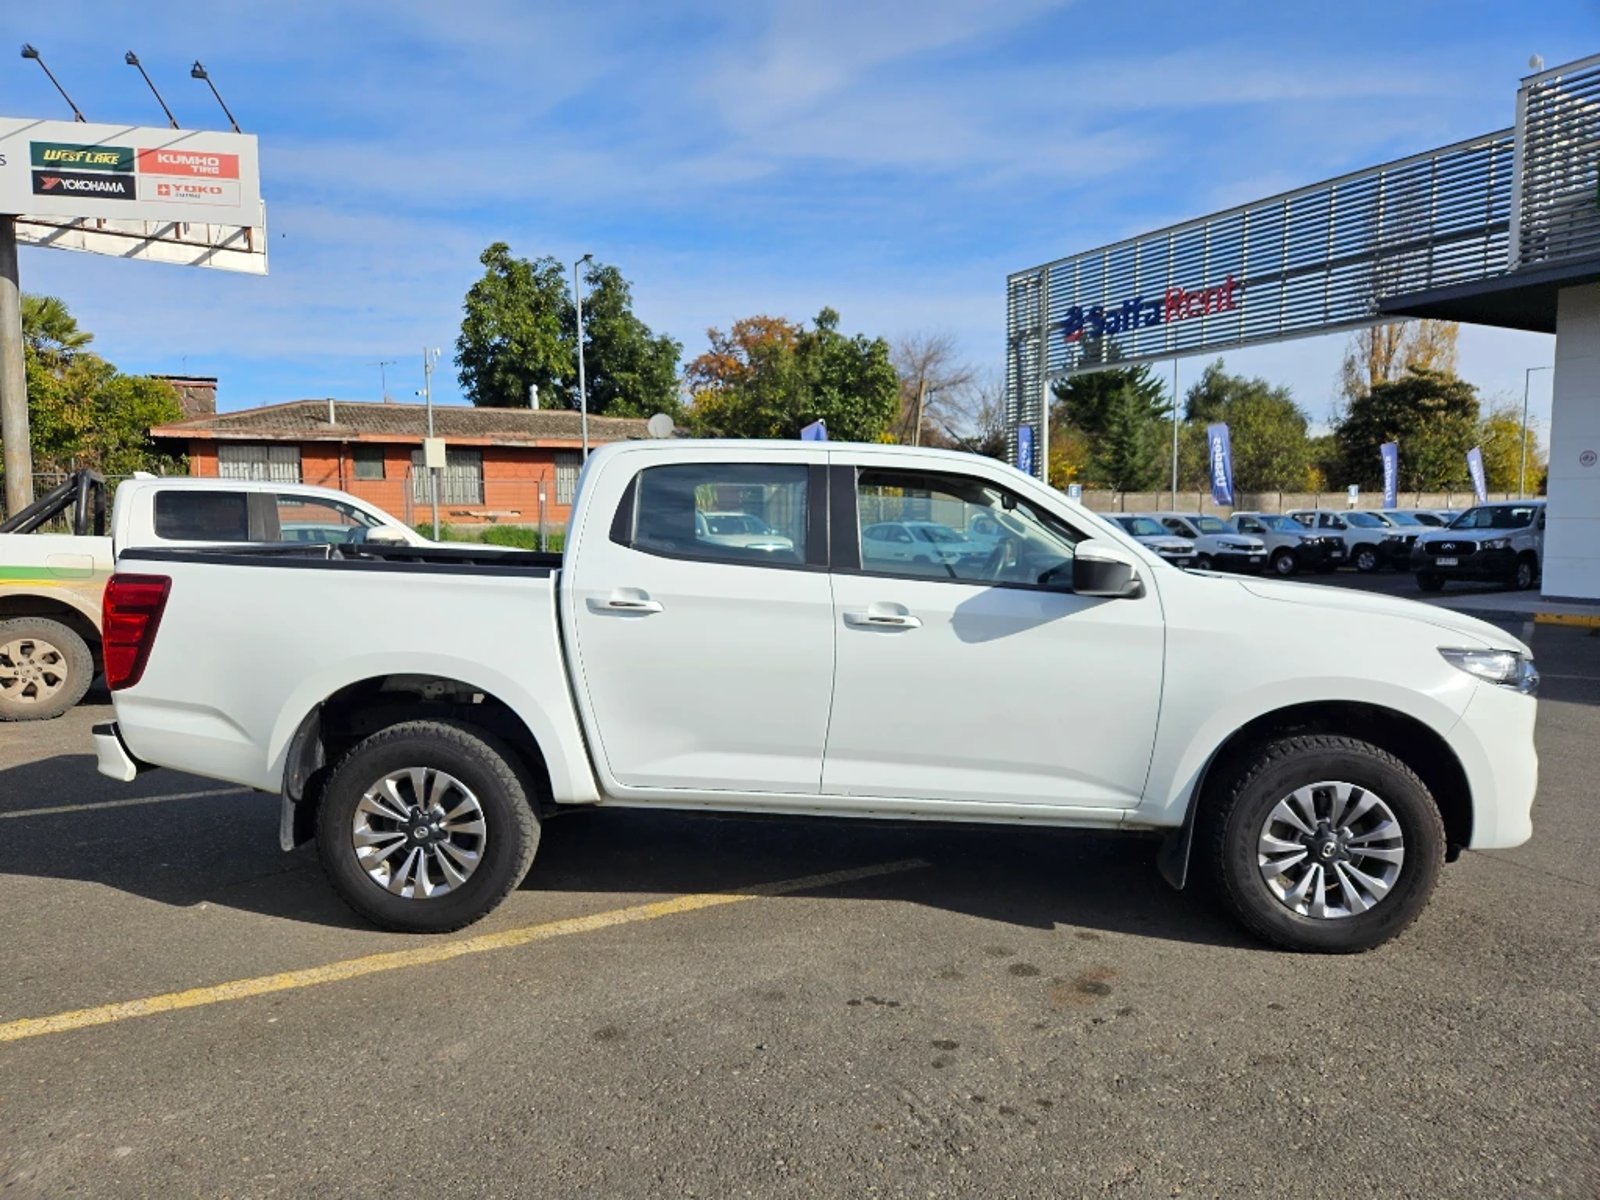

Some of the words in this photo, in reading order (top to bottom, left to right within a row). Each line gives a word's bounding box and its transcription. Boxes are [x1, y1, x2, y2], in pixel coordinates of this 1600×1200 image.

[85, 152, 119, 165] LAKE
[157, 153, 219, 167] KUMHO
[60, 179, 125, 193] YOKOHAMA
[172, 184, 222, 195] YOKO
